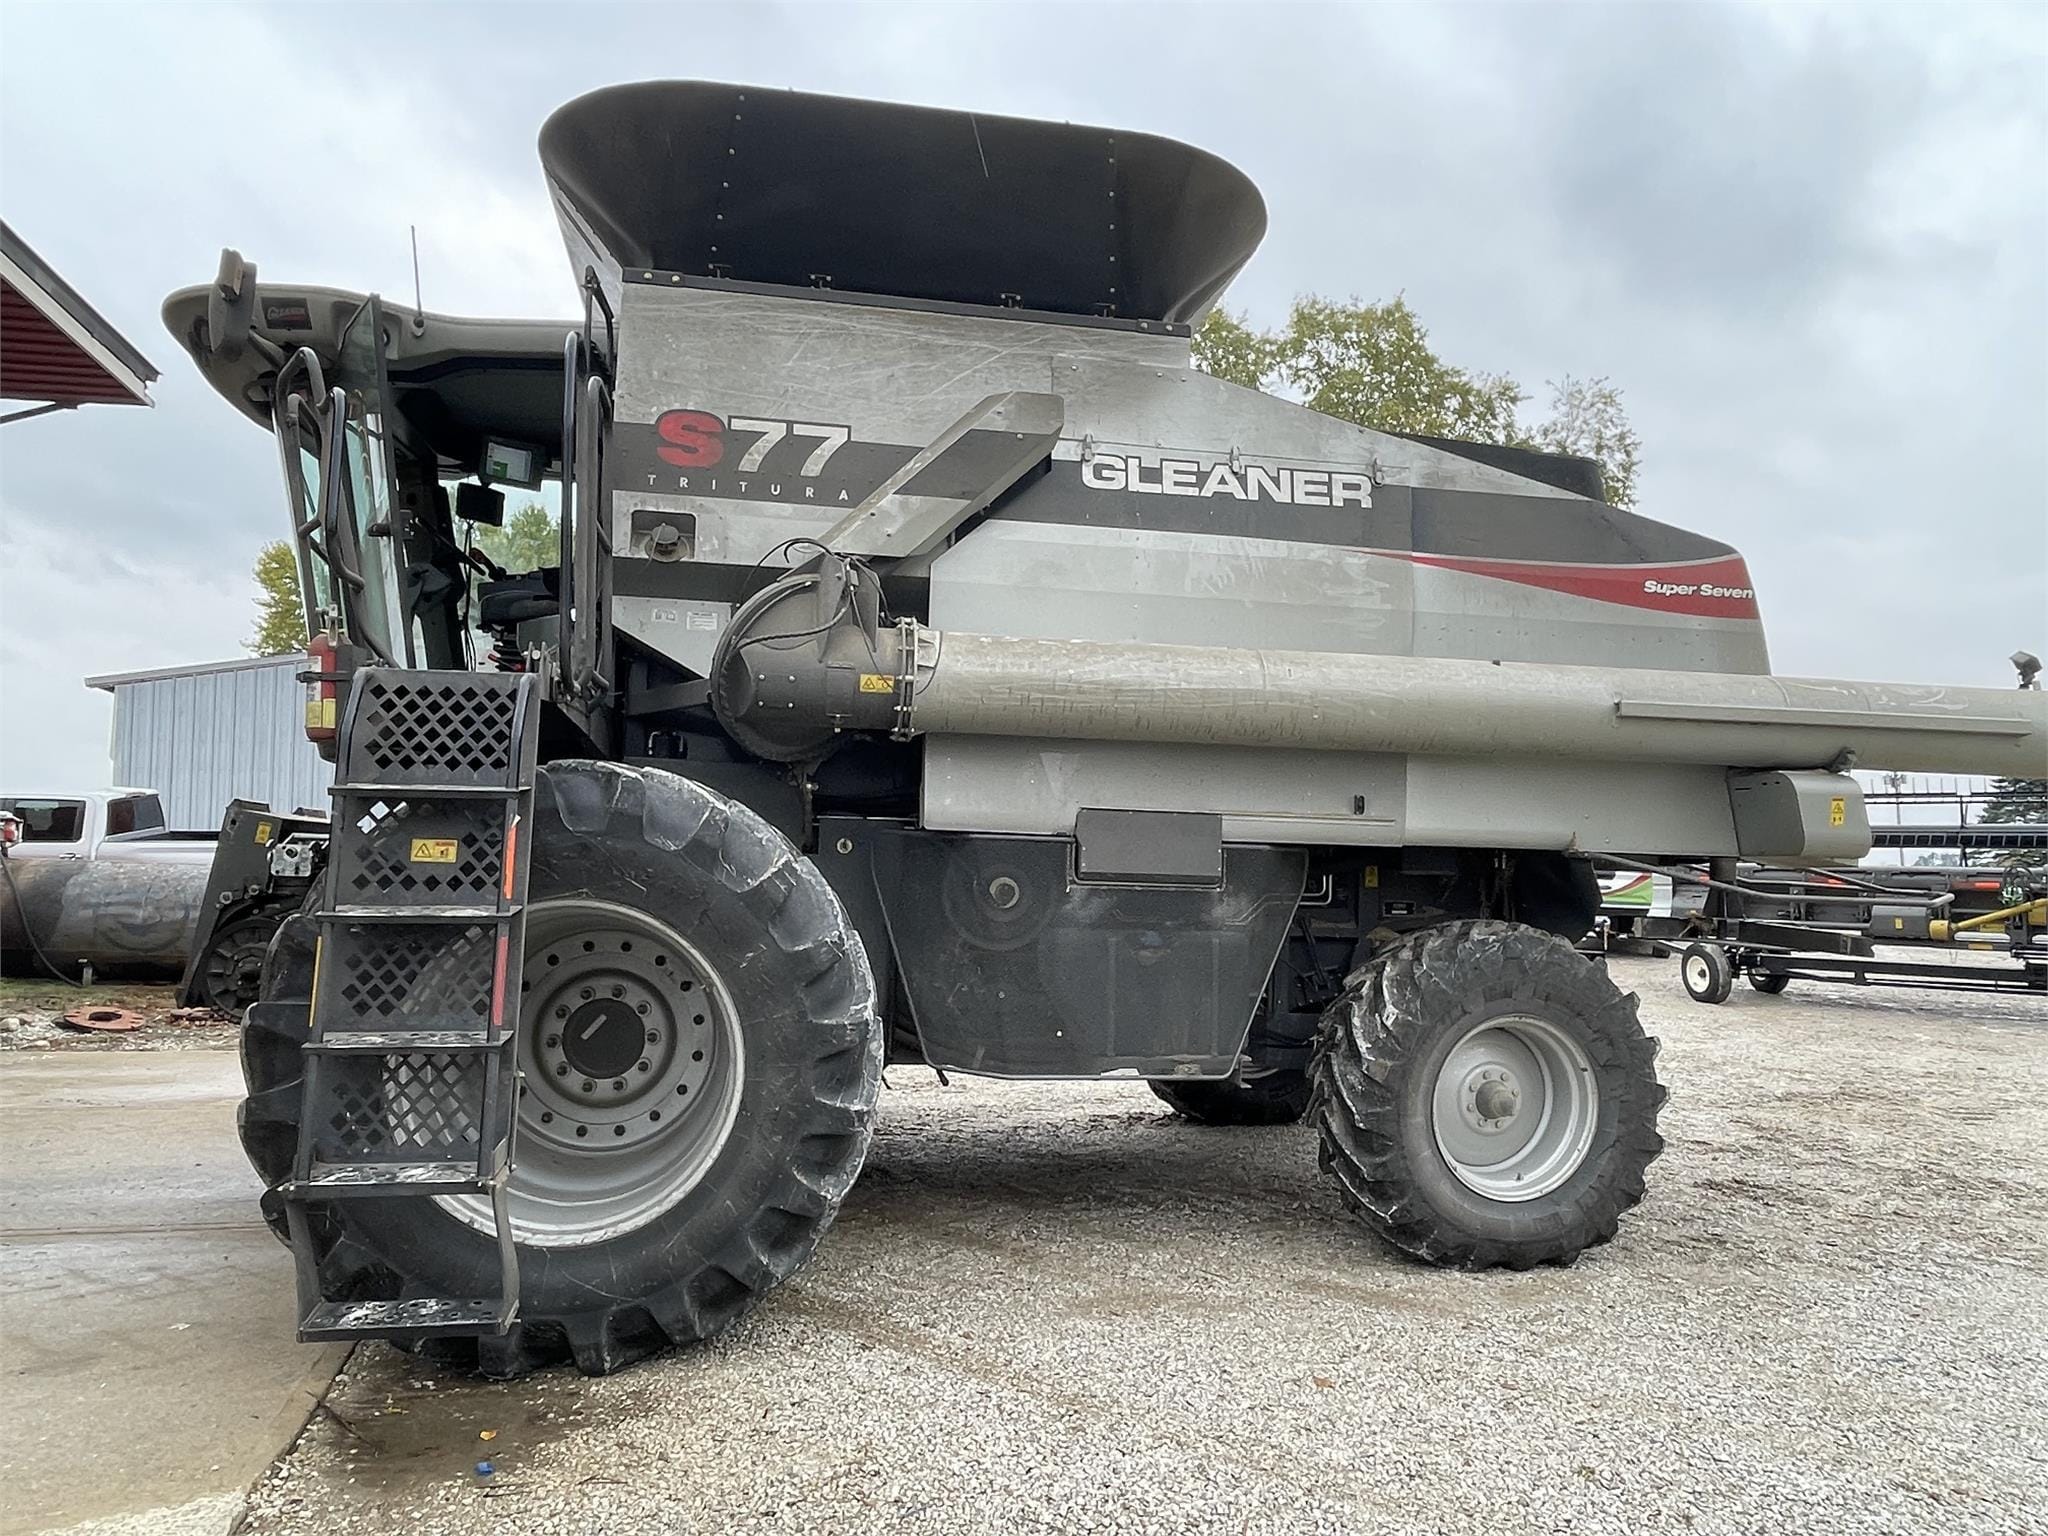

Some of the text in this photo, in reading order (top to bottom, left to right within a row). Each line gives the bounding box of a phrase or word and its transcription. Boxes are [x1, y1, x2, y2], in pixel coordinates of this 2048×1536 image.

[655, 409, 851, 477] S77
[647, 474, 849, 501] TRITURA
[1081, 453, 1373, 509] GLEANER
[1643, 580, 1753, 599] Super Seven
